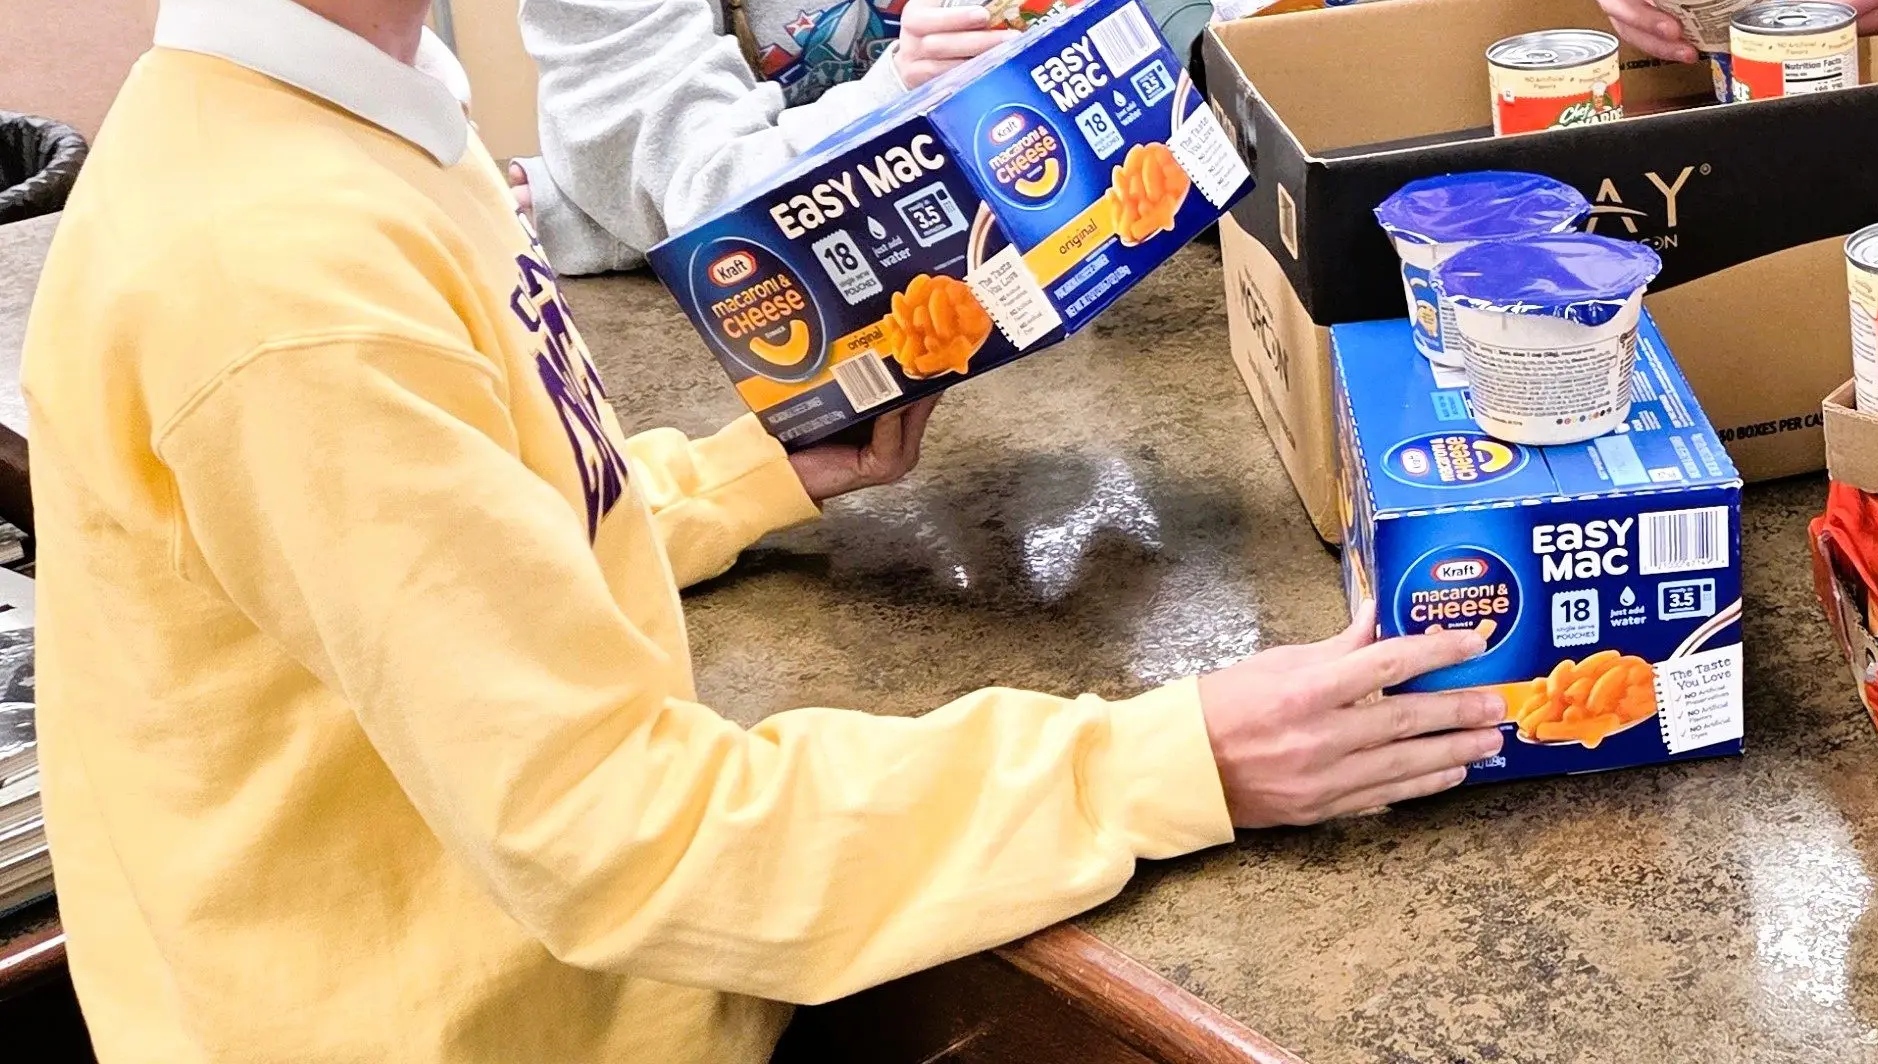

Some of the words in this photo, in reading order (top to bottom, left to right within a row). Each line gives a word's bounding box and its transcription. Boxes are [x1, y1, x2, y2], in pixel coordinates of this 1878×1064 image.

[1784, 61, 1822, 71] Nutrition
[1084, 113, 1108, 137] 18
[1559, 102, 1594, 127] Chef
[997, 121, 1018, 138] Kraft
[988, 129, 1041, 171] macaroni
[913, 205, 941, 229] 3.5
[1059, 218, 1098, 254] original
[824, 242, 859, 275] 18
[879, 246, 911, 268] water
[716, 259, 748, 281] Kraft
[711, 277, 780, 318] macaroni
[777, 273, 792, 288] &
[847, 325, 884, 350] original
[1736, 421, 1777, 441] BOXES
[1779, 416, 1803, 433] PER
[1442, 564, 1475, 579] Kraft
[1411, 584, 1495, 604] macaroni
[1496, 583, 1509, 596] &
[1669, 591, 1695, 608] 3.5
[1559, 598, 1590, 623] 18
[1610, 608, 1627, 618] just
[1628, 605, 1645, 615] add
[1610, 616, 1647, 627] water
[1556, 630, 1596, 641] POUCHES
[1670, 669, 1693, 681] The
[1695, 658, 1731, 674] Taste
[1677, 679, 1699, 691] You
[1702, 670, 1732, 684] Love
[1690, 725, 1702, 733] NO
